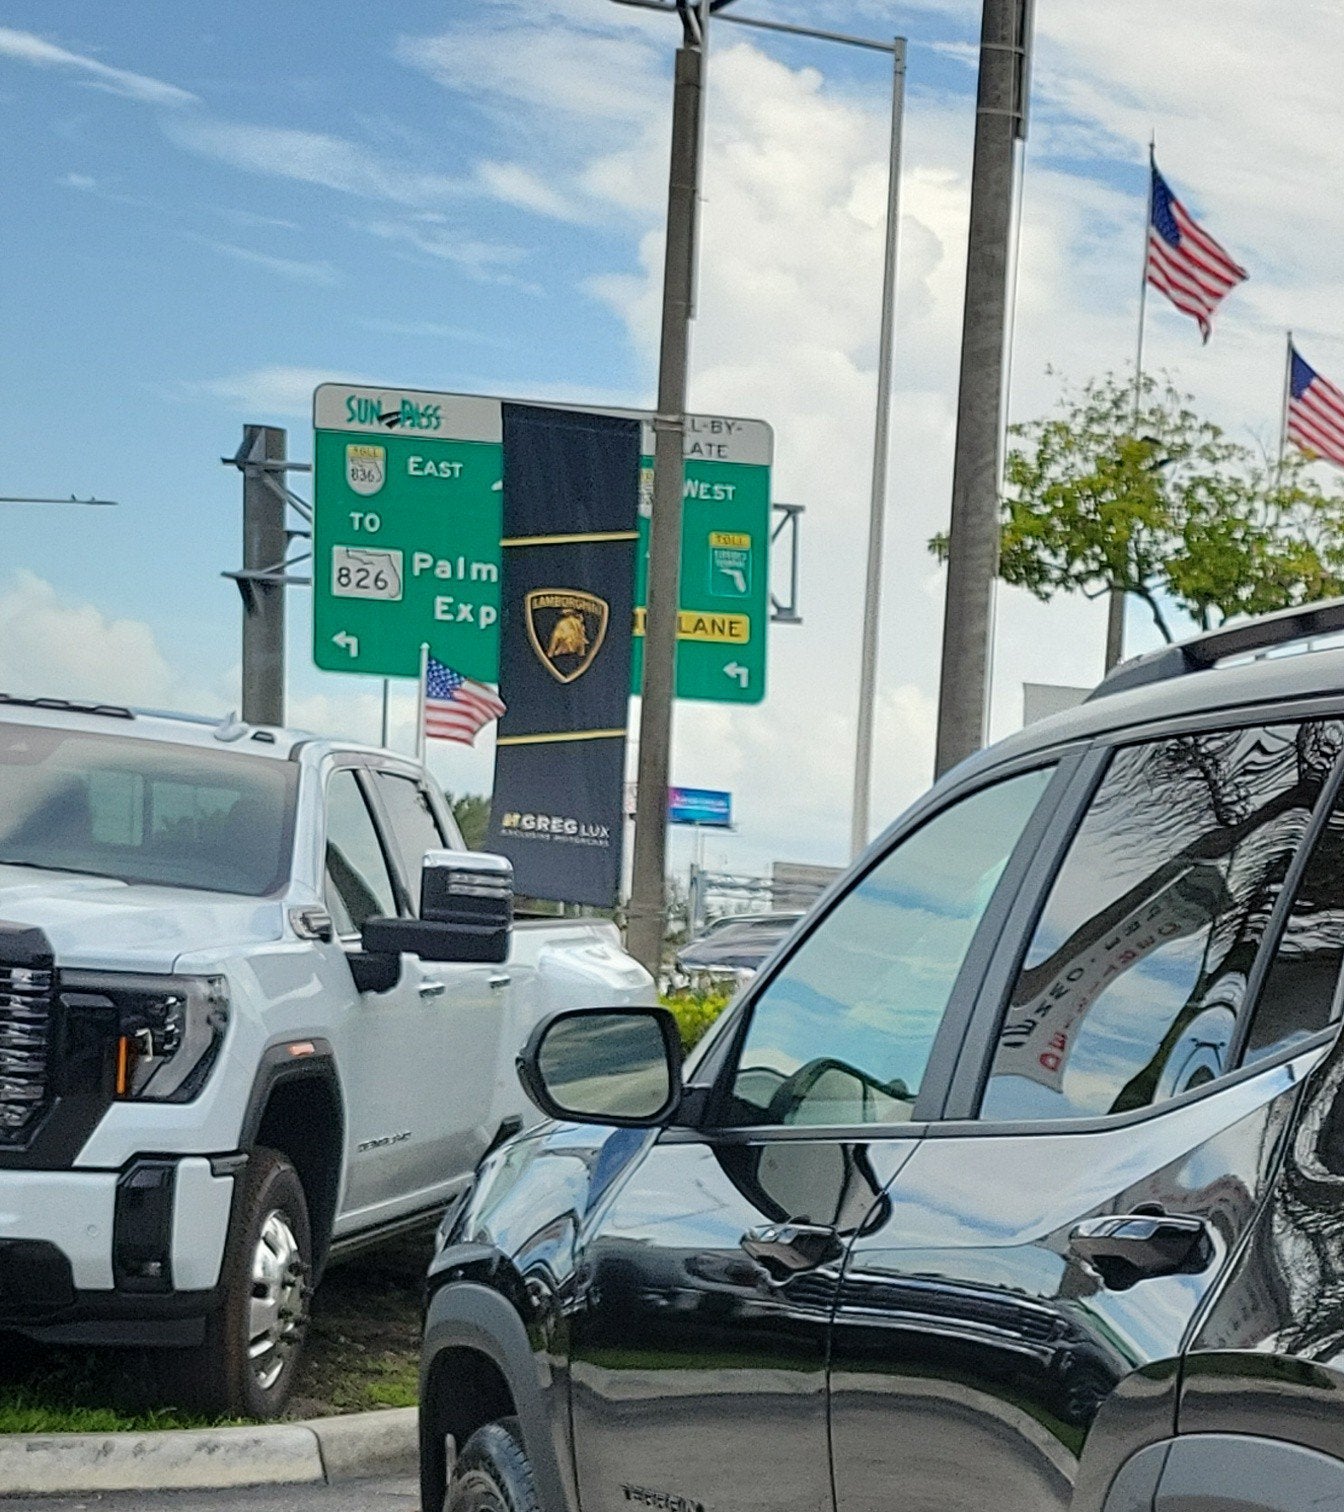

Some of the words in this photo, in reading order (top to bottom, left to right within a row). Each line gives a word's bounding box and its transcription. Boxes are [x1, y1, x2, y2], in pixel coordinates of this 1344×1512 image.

[684, 442, 728, 458] ATE
[408, 456, 463, 478] EAST
[684, 479, 736, 500] WEST
[350, 512, 380, 532] TO
[412, 552, 498, 582] Palm
[337, 567, 388, 590] 826
[434, 596, 498, 629] Exp
[678, 616, 743, 638] LANE
